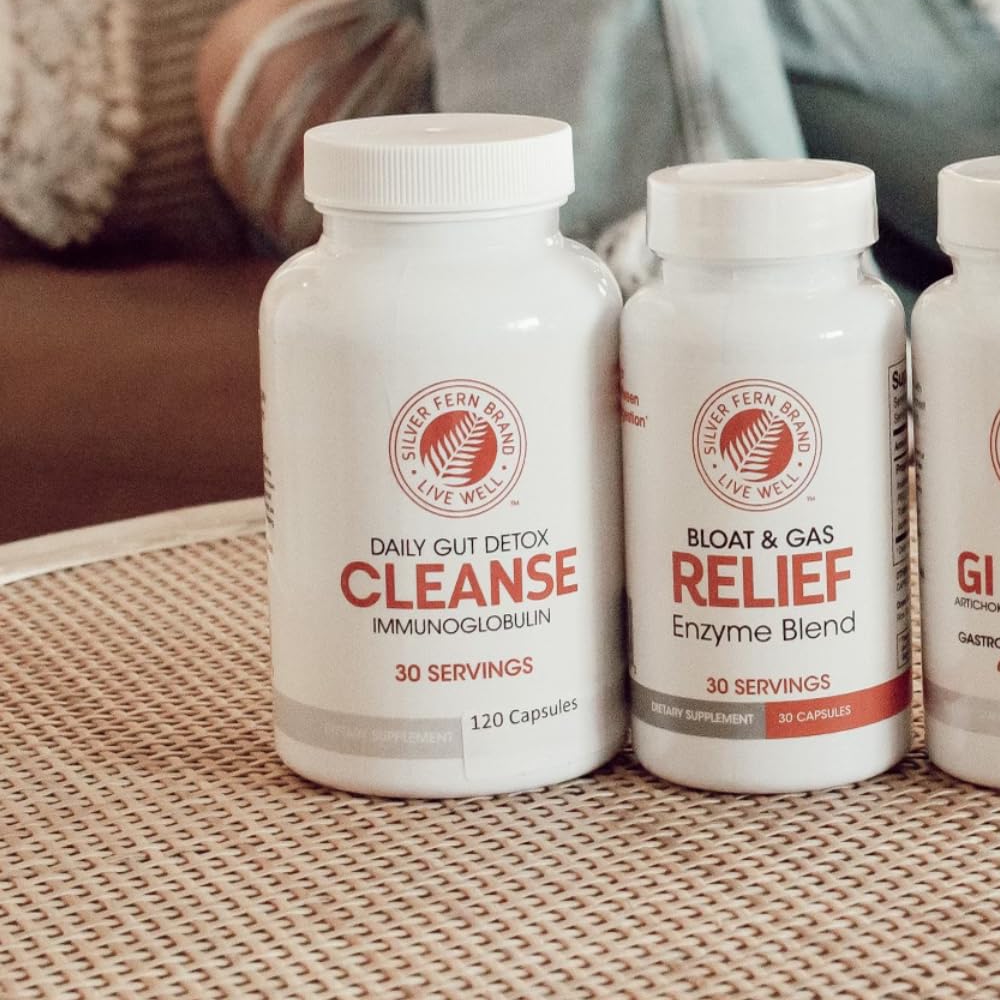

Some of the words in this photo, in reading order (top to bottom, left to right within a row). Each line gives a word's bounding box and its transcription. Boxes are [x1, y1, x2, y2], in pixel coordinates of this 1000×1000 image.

[402, 406, 431, 460] SILVER
[433, 392, 480, 410] FERN
[483, 402, 515, 455] BRAND
[703, 403, 730, 455] SILVER
[732, 391, 776, 408] FERN
[780, 401, 811, 453] BRAND
[417, 479, 454, 505] LIVE
[459, 477, 504, 505] WELL
[718, 473, 752, 499] LIVE
[756, 473, 799, 499] WELL
[370, 537, 426, 557] DAILY
[433, 537, 478, 556] GUT
[485, 528, 550, 554] DETOX
[687, 527, 755, 549] BLOAT
[761, 530, 778, 549] &
[786, 525, 834, 548] GAS
[340, 546, 579, 610] CLEANSE
[672, 546, 853, 609] RELIEF
[957, 551, 994, 596] GI
[372, 608, 551, 636] IMMUNOGLOBULIN
[672, 613, 772, 648] Enzyme
[782, 609, 856, 642] Blend
[395, 663, 421, 683] 30
[427, 656, 533, 683] SERVINGS
[706, 677, 729, 695] 30
[734, 673, 831, 696] SERVINGS
[470, 711, 504, 731] 120
[508, 697, 579, 726] Capsules
[651, 700, 683, 718] DIETARY
[685, 709, 755, 726] SUPPLEMENT
[778, 712, 793, 724] 30
[797, 705, 852, 721] CAPSULES
